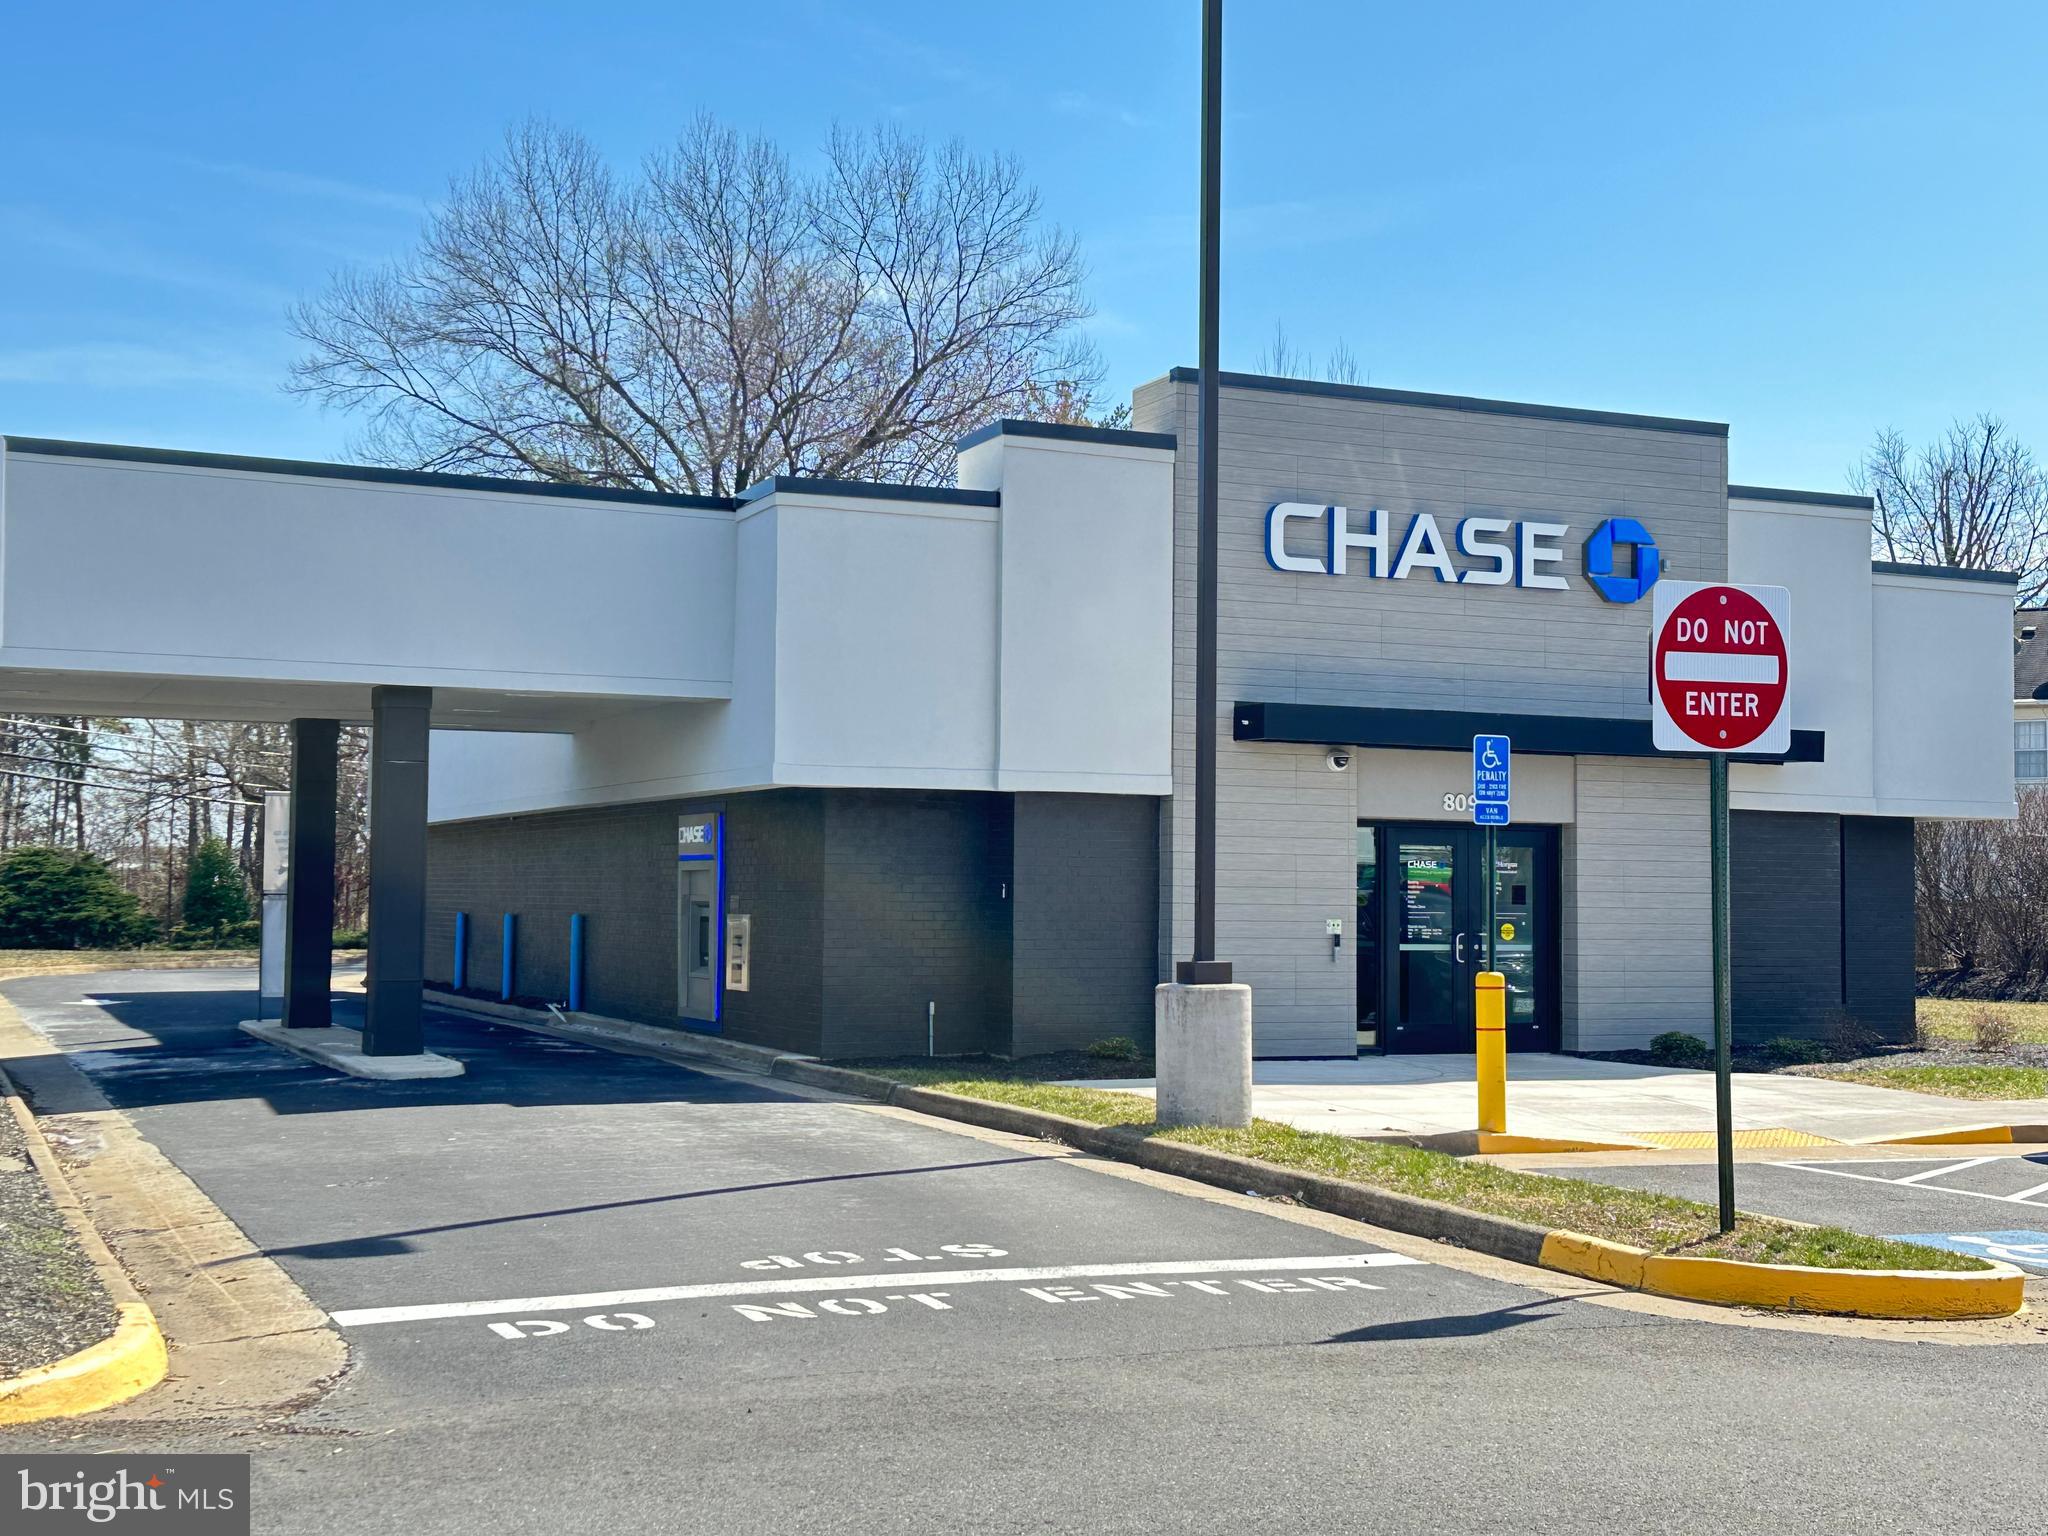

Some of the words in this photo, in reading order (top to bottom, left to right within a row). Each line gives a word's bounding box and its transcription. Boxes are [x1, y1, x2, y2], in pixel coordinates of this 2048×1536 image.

[1264, 502, 1571, 591] CHASE
[1676, 617, 1709, 644] DO
[1723, 620, 1769, 646] NOT
[1684, 690, 1760, 718] ENTER
[1477, 770, 1507, 781] PENALTY
[678, 825, 705, 843] CHASE
[1407, 860, 1438, 869] CHASE
[738, 1242, 1009, 1271] STOP
[487, 1312, 656, 1340] DO
[729, 1291, 953, 1322] NOT
[1019, 1276, 1388, 1303] ENTER
